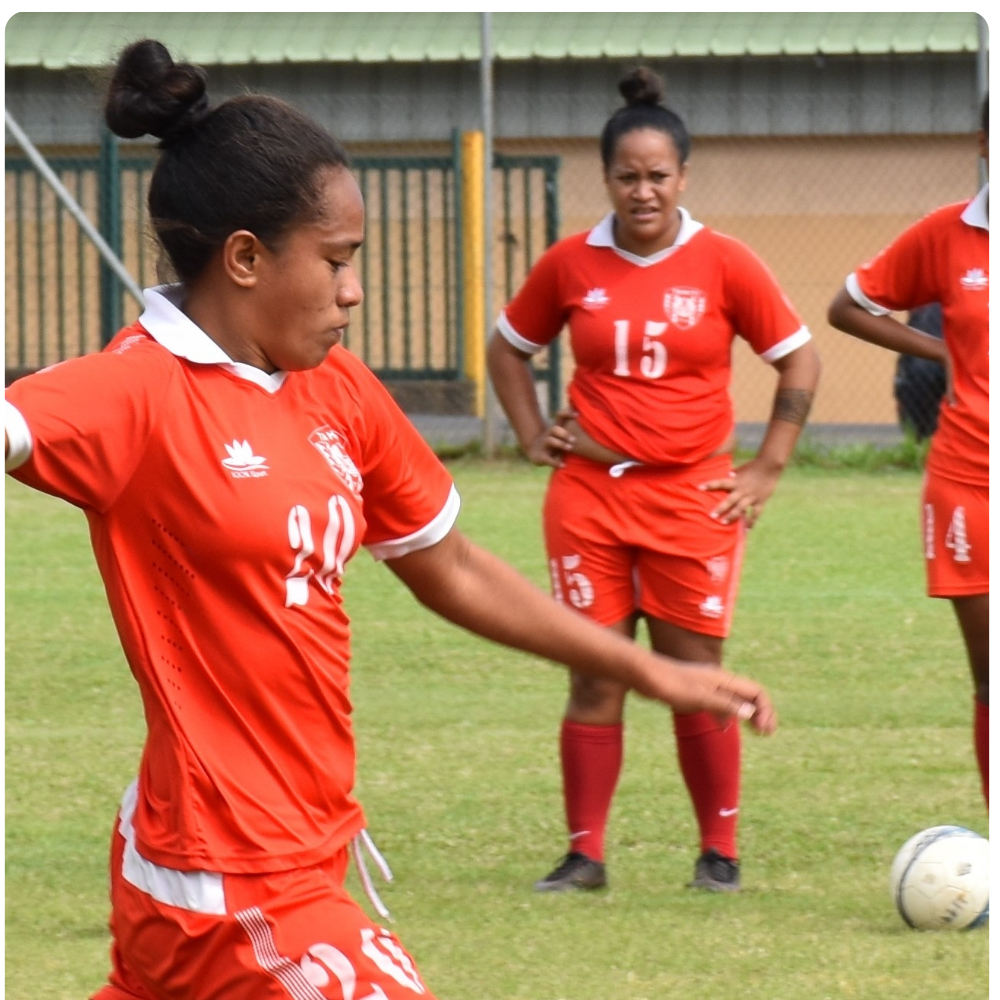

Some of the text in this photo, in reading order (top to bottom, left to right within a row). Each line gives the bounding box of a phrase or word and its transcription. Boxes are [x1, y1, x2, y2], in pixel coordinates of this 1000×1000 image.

[613, 319, 669, 379] 15
[285, 494, 355, 608] 20
[924, 503, 972, 562] 14
[551, 554, 595, 609] 15
